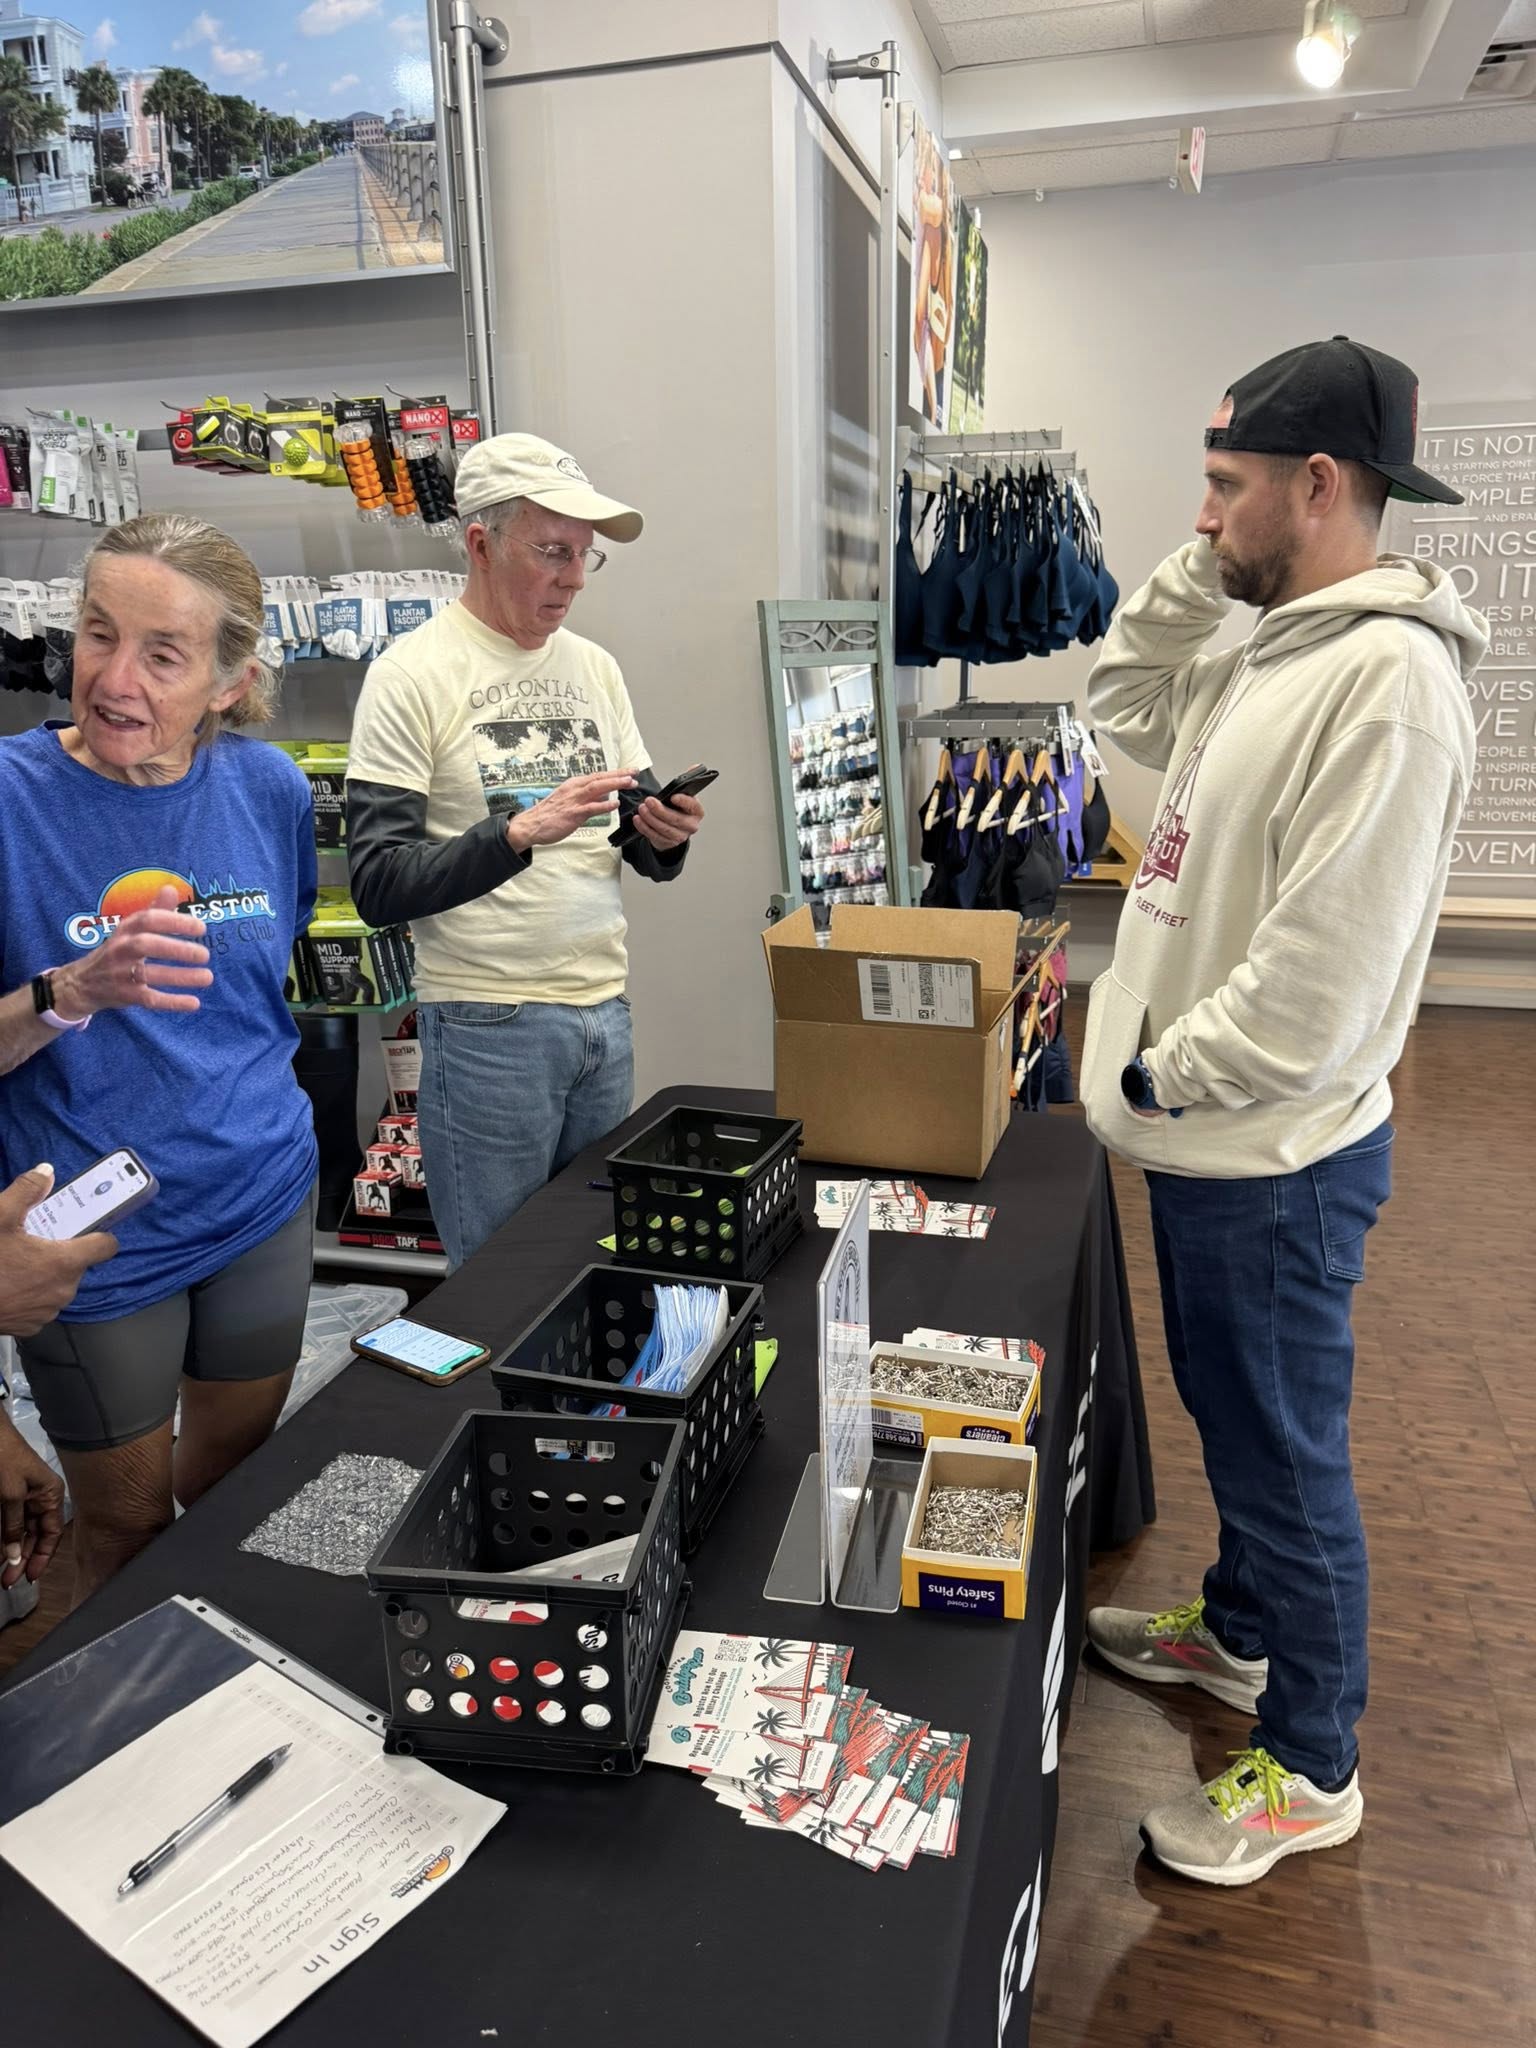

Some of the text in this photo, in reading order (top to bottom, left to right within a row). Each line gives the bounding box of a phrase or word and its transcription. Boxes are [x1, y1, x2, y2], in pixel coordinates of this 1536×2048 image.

[1423, 434, 1536, 458] IT IS NOT
[1452, 461, 1500, 471] STARTING
[1502, 460, 1532, 468] POINT
[1450, 475, 1459, 484] A
[1462, 473, 1503, 484] FORCE
[1507, 471, 1536, 482] THAT
[1484, 513, 1508, 522] AND
[1413, 530, 1536, 558] BRINGS
[1499, 562, 1536, 599] IT
[393, 608, 426, 617] PLANTAR
[1494, 627, 1522, 637] AND
[469, 678, 589, 710] COLONIAL
[1466, 680, 1535, 701] OVES
[497, 702, 576, 720] LAKERS
[1478, 746, 1528, 758] EOPLE
[313, 794, 348, 803] UPPORT
[68, 893, 276, 945] CHESTON
[1160, 911, 1188, 928] FEET
[317, 943, 342, 956] MID
[319, 956, 360, 964] SUPPORT
[928, 1584, 996, 1602] Safety Pins
[947, 1600, 969, 1608] Closed
[230, 1626, 253, 1645] Staples
[704, 1670, 728, 1716] Military Challenge
[692, 1694, 707, 1718] Register
[688, 1732, 706, 1759] Register
[327, 1910, 381, 1955] Sign
[303, 1948, 329, 1976] In
